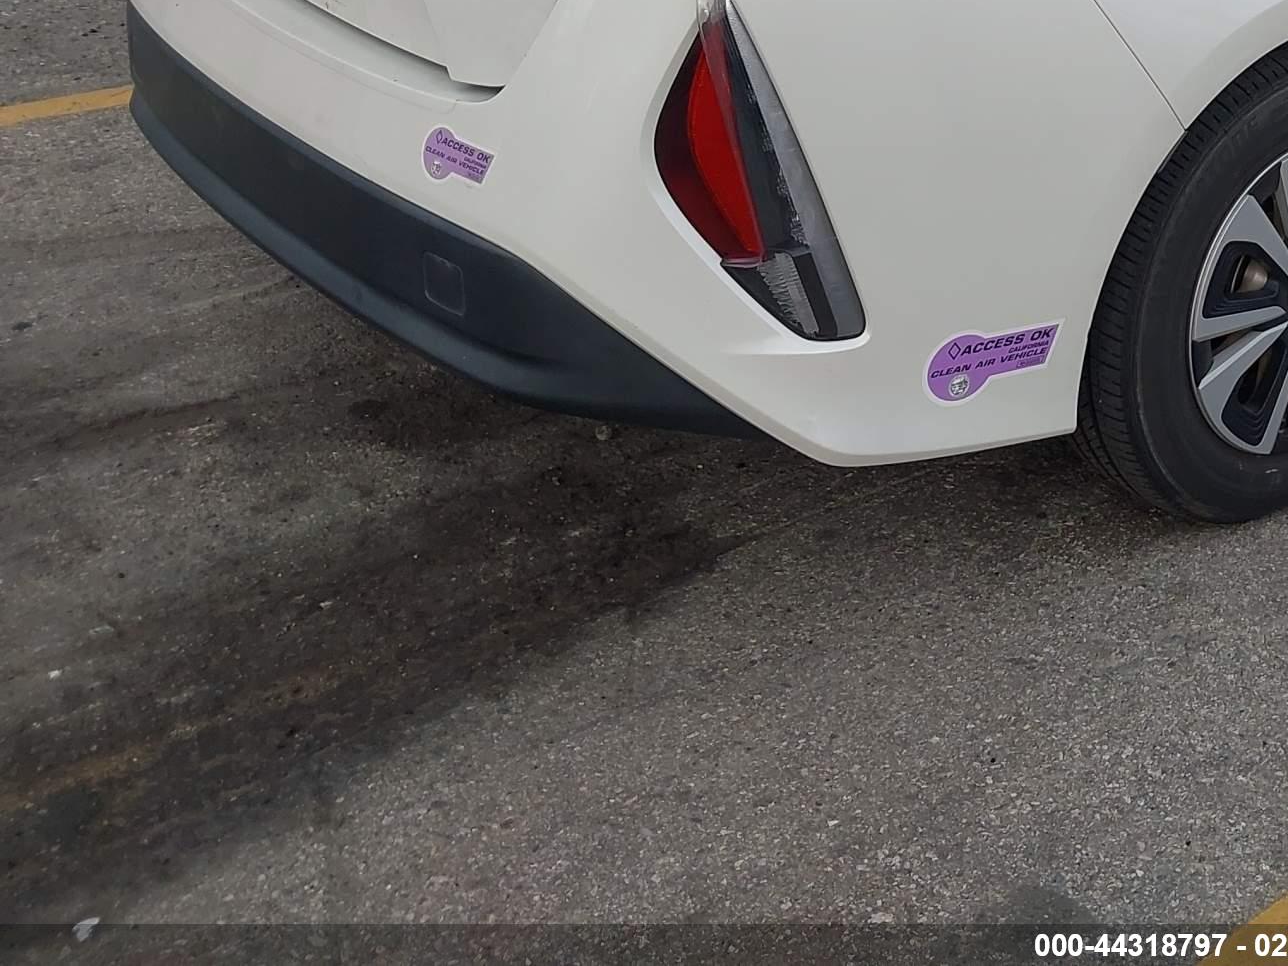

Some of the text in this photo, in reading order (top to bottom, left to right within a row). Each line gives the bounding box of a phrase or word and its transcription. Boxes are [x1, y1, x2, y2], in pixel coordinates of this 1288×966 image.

[425, 145, 485, 175] CLEAN AIR VEHICLE
[441, 137, 491, 164] ACCESS OK
[960, 327, 1055, 357] ACCESS OK
[1008, 340, 1050, 354] CALIFORNIA
[930, 364, 972, 379] CLEAN
[975, 358, 996, 370] AIR
[1000, 347, 1049, 363] VEHICLE
